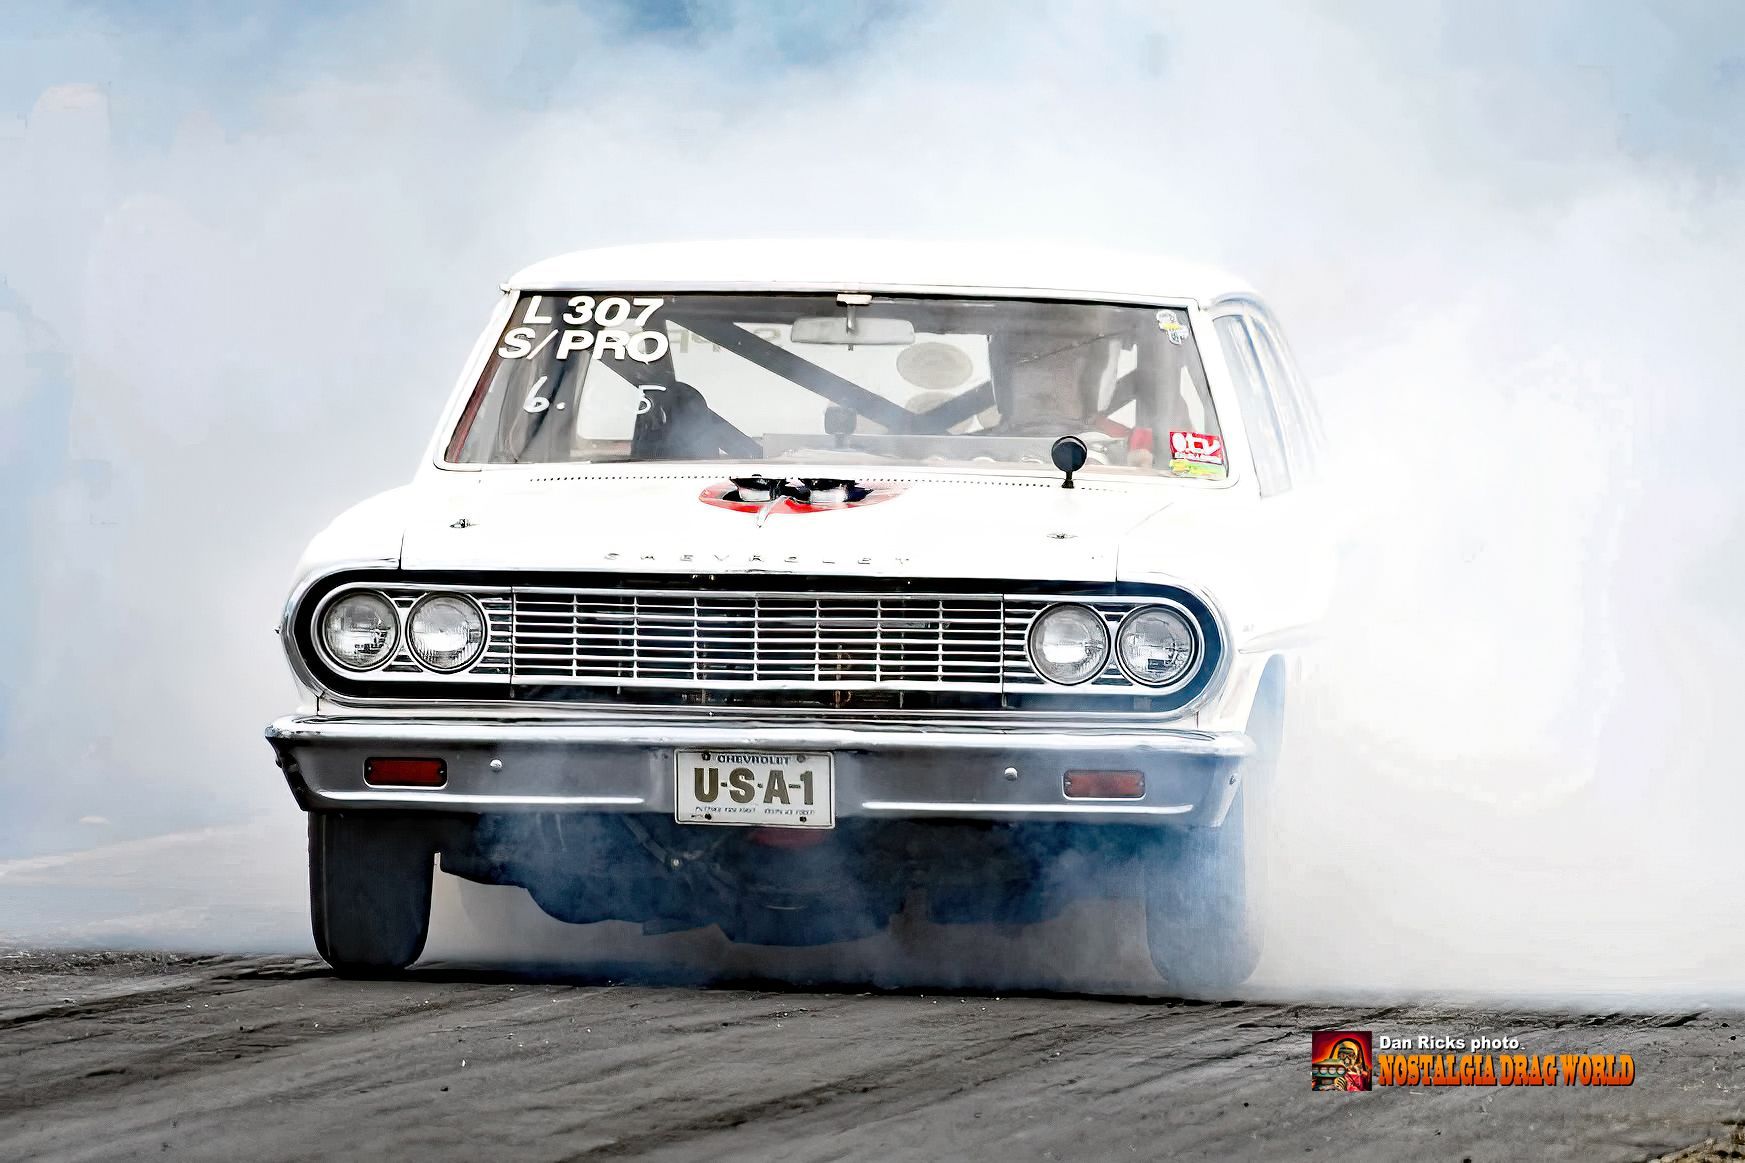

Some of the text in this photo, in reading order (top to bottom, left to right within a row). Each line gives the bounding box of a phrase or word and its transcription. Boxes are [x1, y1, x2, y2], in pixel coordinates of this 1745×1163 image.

[523, 295, 665, 327] L 307
[498, 327, 669, 363] S/PRO
[717, 754, 791, 765] CHEVROLET
